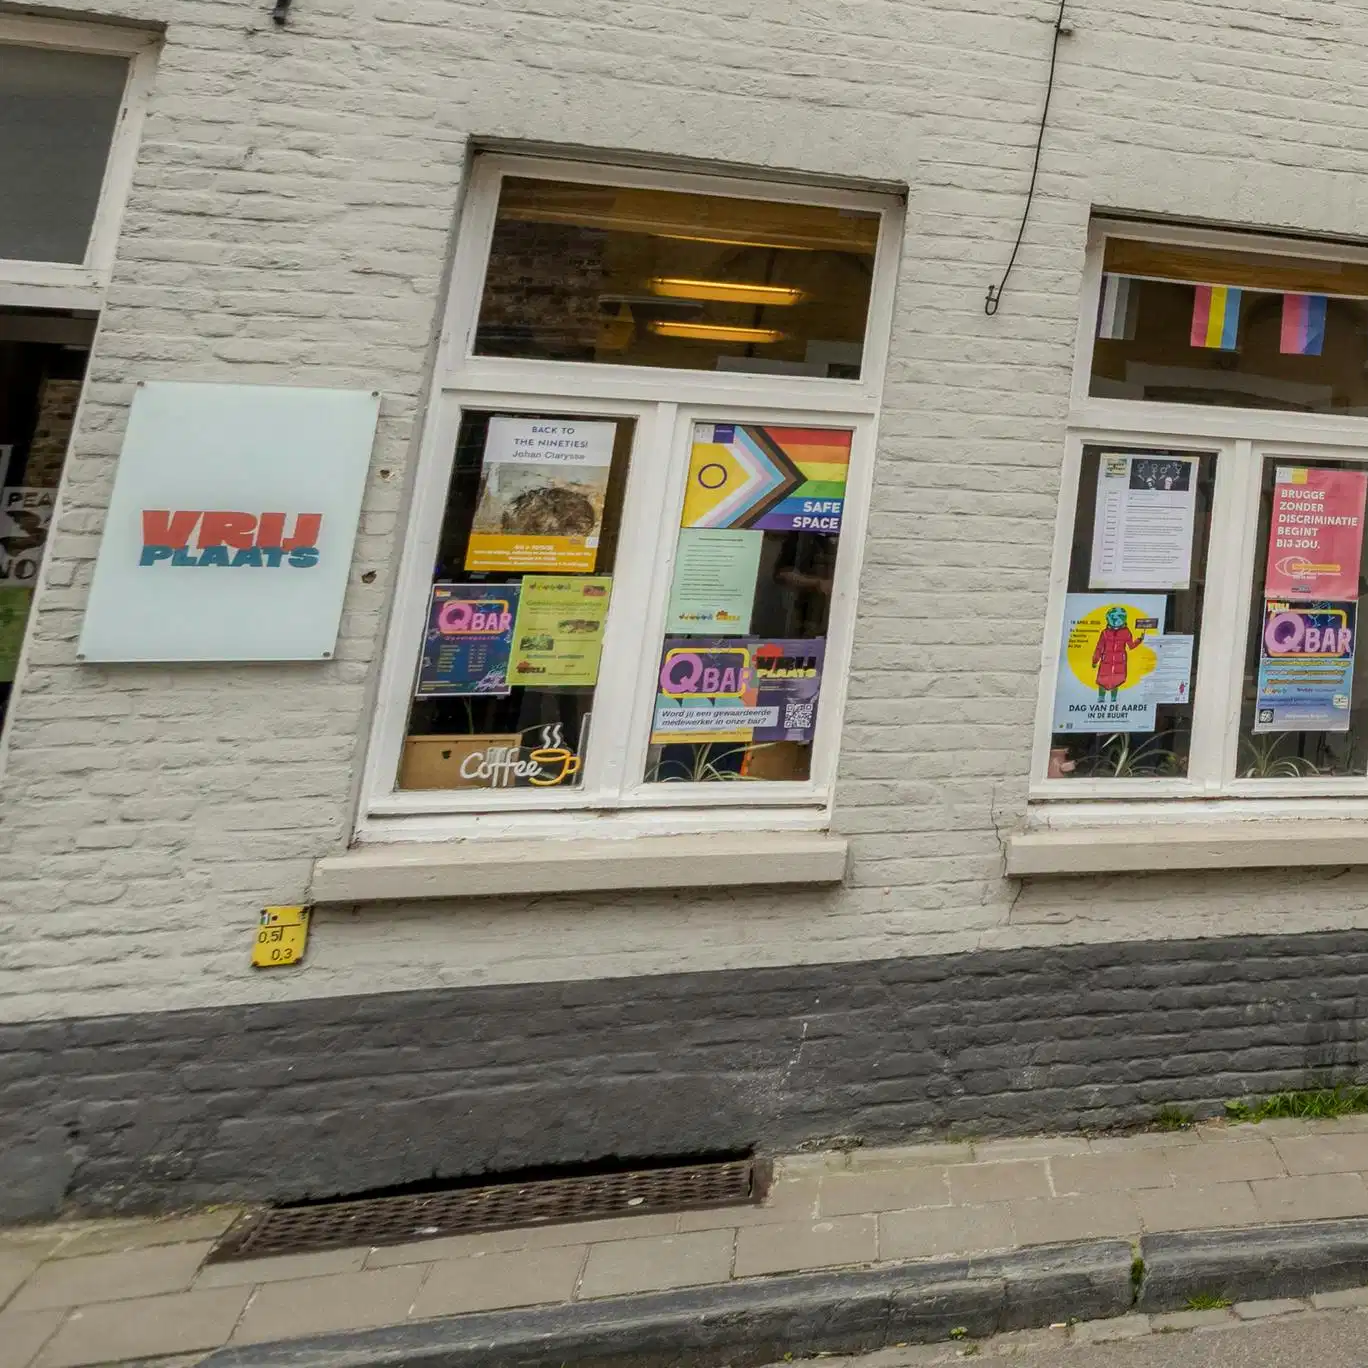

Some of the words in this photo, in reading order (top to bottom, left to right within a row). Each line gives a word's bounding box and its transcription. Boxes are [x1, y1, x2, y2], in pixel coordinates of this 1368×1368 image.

[531, 425, 559, 434] BACK
[561, 427, 575, 435] TO
[514, 438, 534, 446] THE
[538, 439, 588, 448] NINETIES!
[512, 450, 542, 458] Johan
[1280, 489, 1326, 500] BRUGGE
[803, 501, 841, 514] SAFE
[1279, 501, 1324, 512] ZONDER
[792, 516, 840, 529] SPACE
[1278, 514, 1359, 527] DISCRIMINATIE
[142, 509, 323, 552] VRIJ
[1277, 526, 1319, 536] BEGINT
[1276, 539, 1294, 548] BIJ
[1295, 539, 1320, 549] JOU.
[139, 545, 320, 568] PLAATS
[1121, 704, 1148, 712] AARDE
[685, 711, 694, 719] jij
[713, 709, 772, 719] gewaardeerde
[661, 718, 713, 726] medewerker
[747, 717, 766, 725] bar?
[460, 747, 543, 788] Coffee
